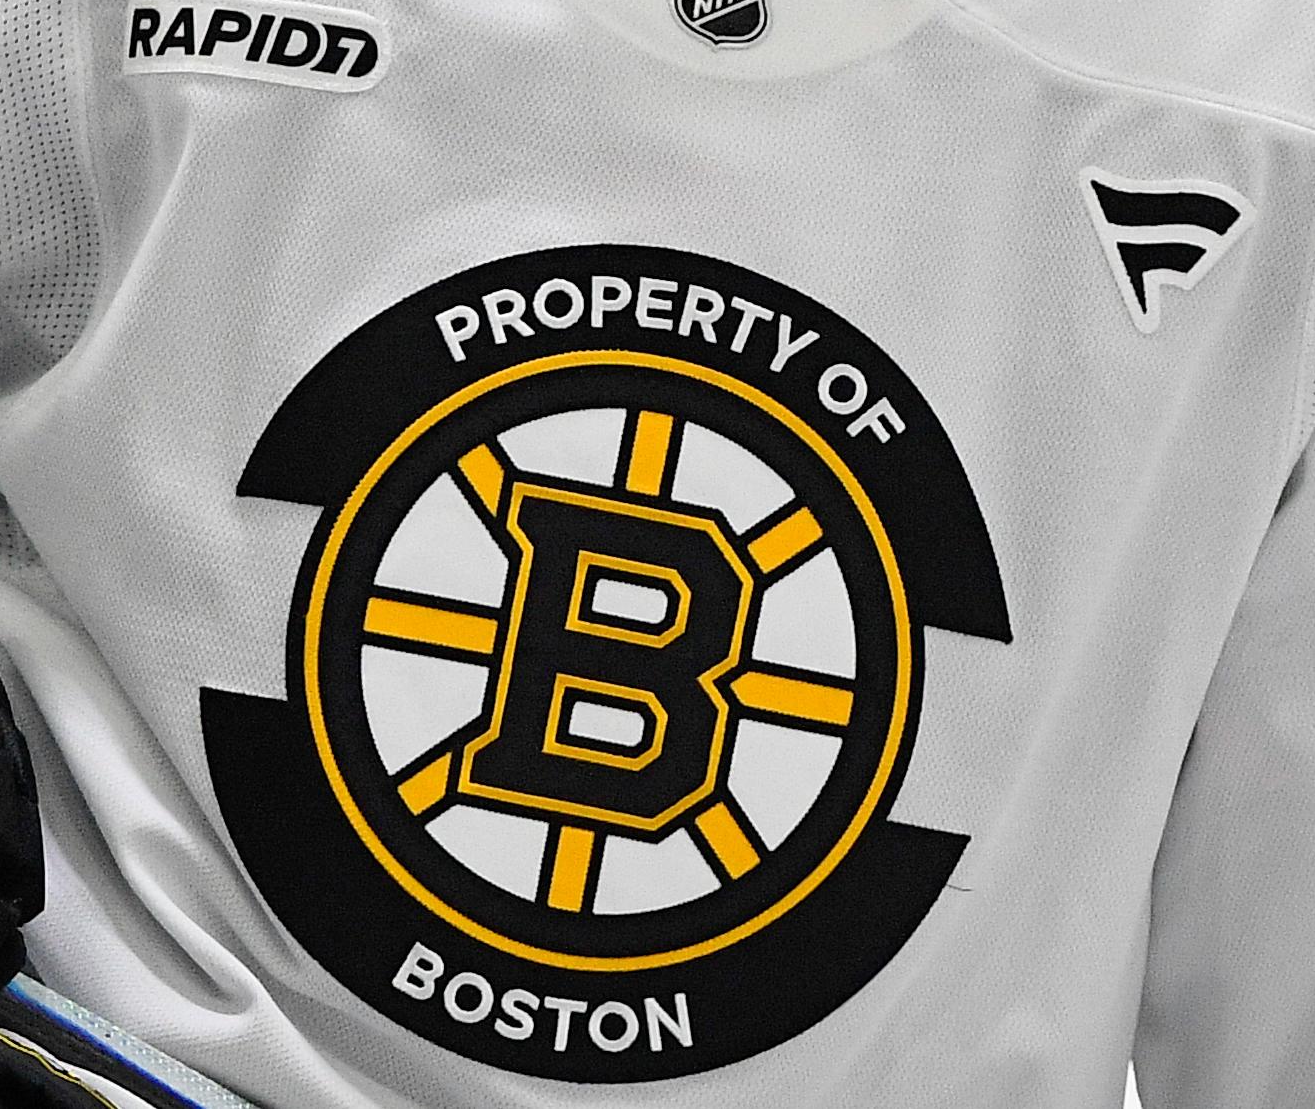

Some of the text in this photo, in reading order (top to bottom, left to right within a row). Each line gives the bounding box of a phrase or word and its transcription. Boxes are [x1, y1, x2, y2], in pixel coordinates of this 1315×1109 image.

[128, 7, 379, 78] RAPID7
[435, 276, 906, 446] PROPERTY OF
[458, 482, 753, 831] B
[392, 941, 693, 1053] BOSTON
